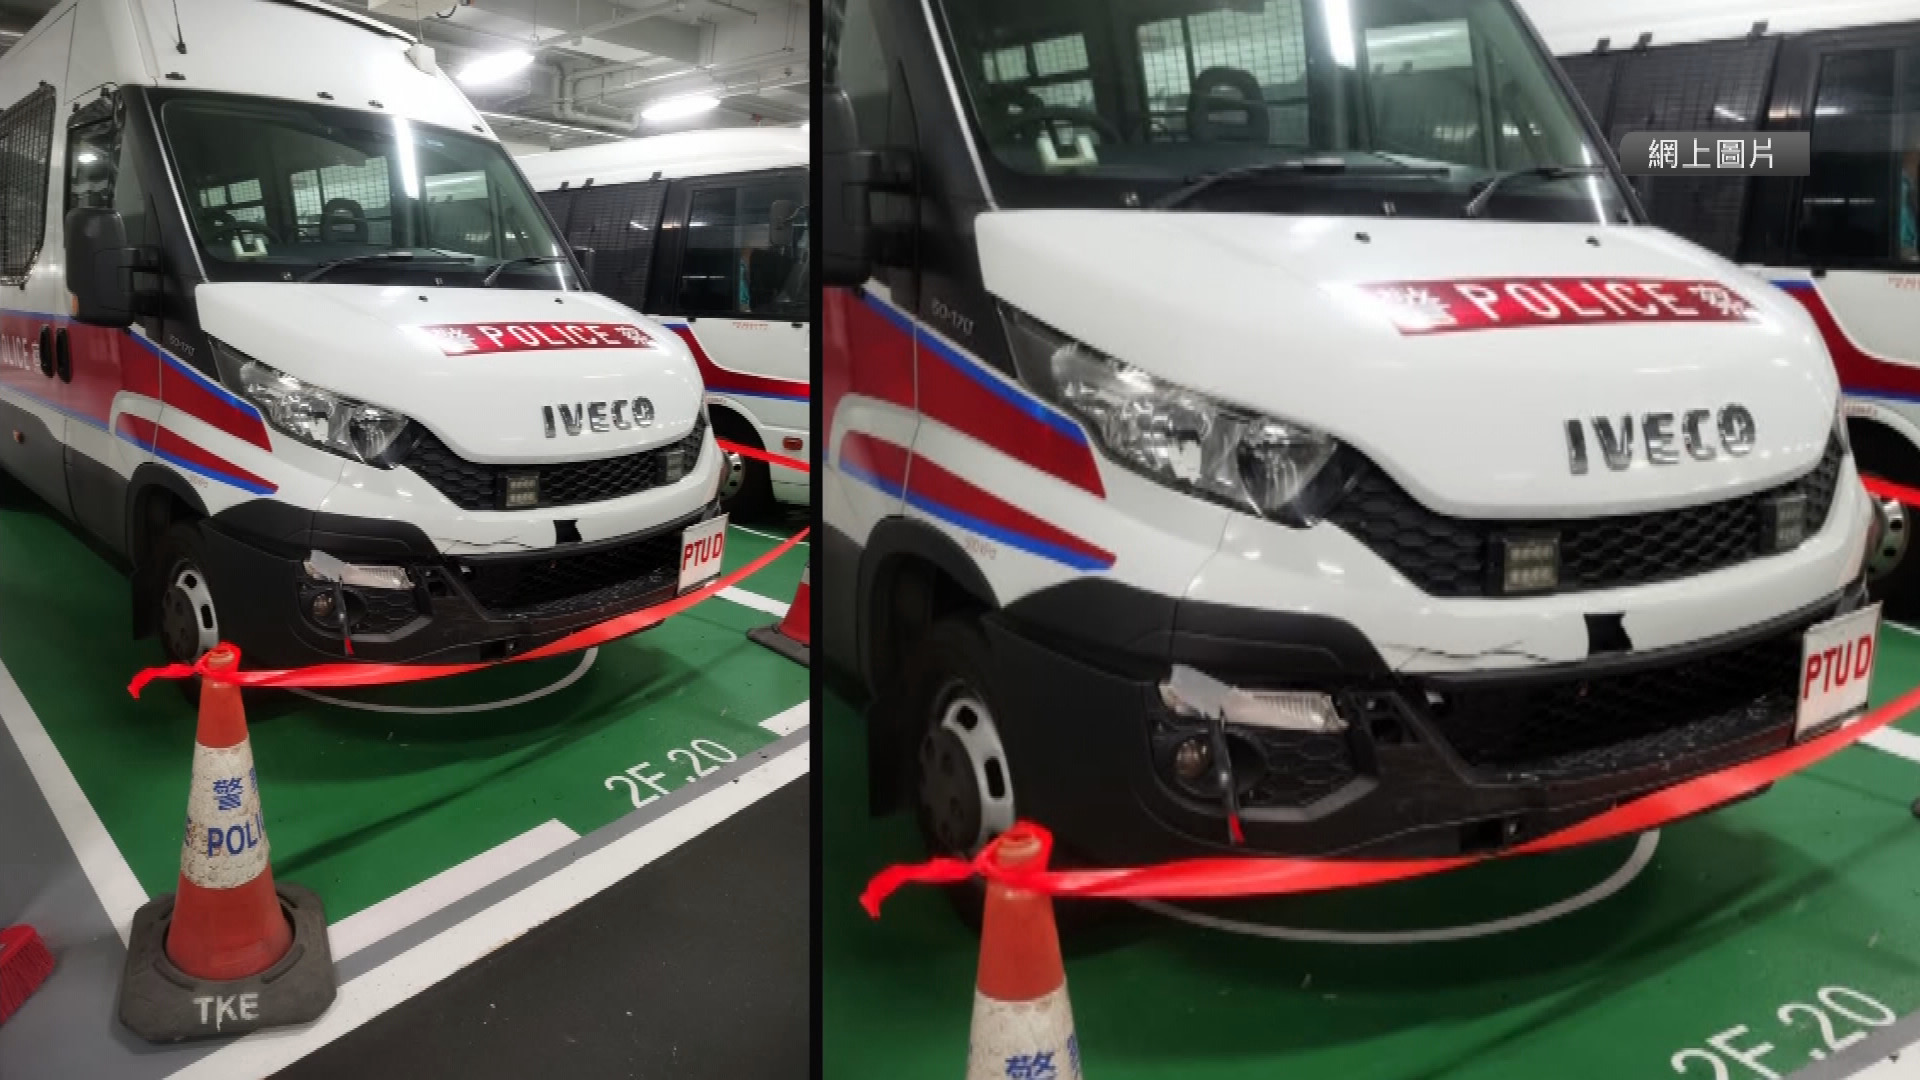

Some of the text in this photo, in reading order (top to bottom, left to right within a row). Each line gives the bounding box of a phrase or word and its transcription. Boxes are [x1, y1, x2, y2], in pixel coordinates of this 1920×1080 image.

[1454, 282, 1700, 321] POLICE
[477, 325, 621, 348] POLICE
[542, 396, 655, 438] IVECO
[1563, 402, 1756, 475] IVECO
[208, 810, 265, 857] POLI
[193, 993, 259, 1030] TKE
